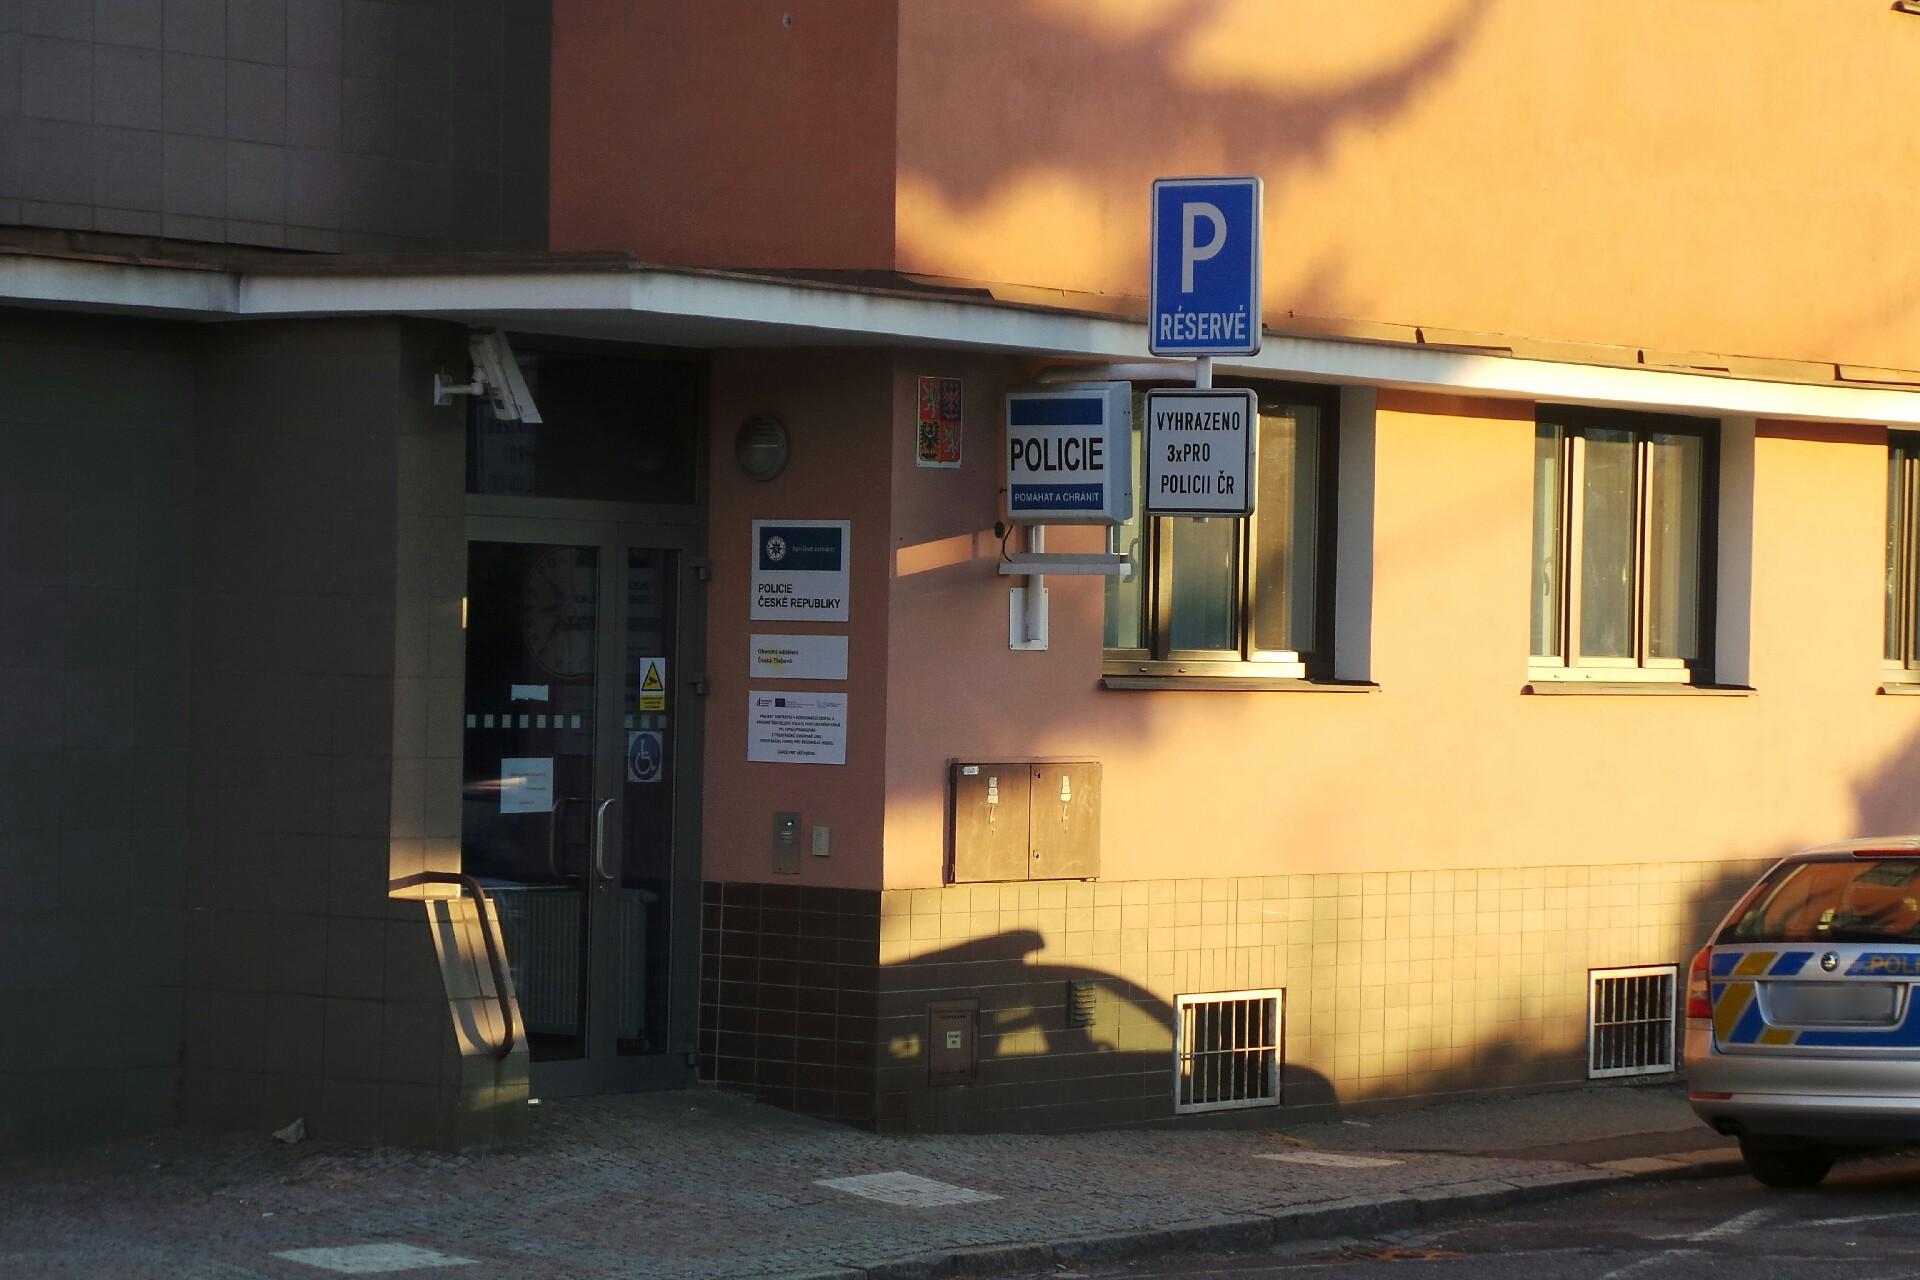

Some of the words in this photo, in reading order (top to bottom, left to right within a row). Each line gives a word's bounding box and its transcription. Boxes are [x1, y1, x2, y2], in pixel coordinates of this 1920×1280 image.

[1181, 202, 1228, 293] P
[1160, 305, 1247, 341] RÉSERVÉ
[1156, 411, 1241, 431] VYHRAZENO
[1010, 437, 1104, 472] POLICIE
[1161, 474, 1211, 494] POLICII
[1217, 470, 1235, 495] ČR
[1055, 493, 1061, 501] A
[758, 583, 793, 594] POLICIE
[758, 595, 788, 607] ČESKÉ
[790, 598, 841, 609] REPUBLIKY
